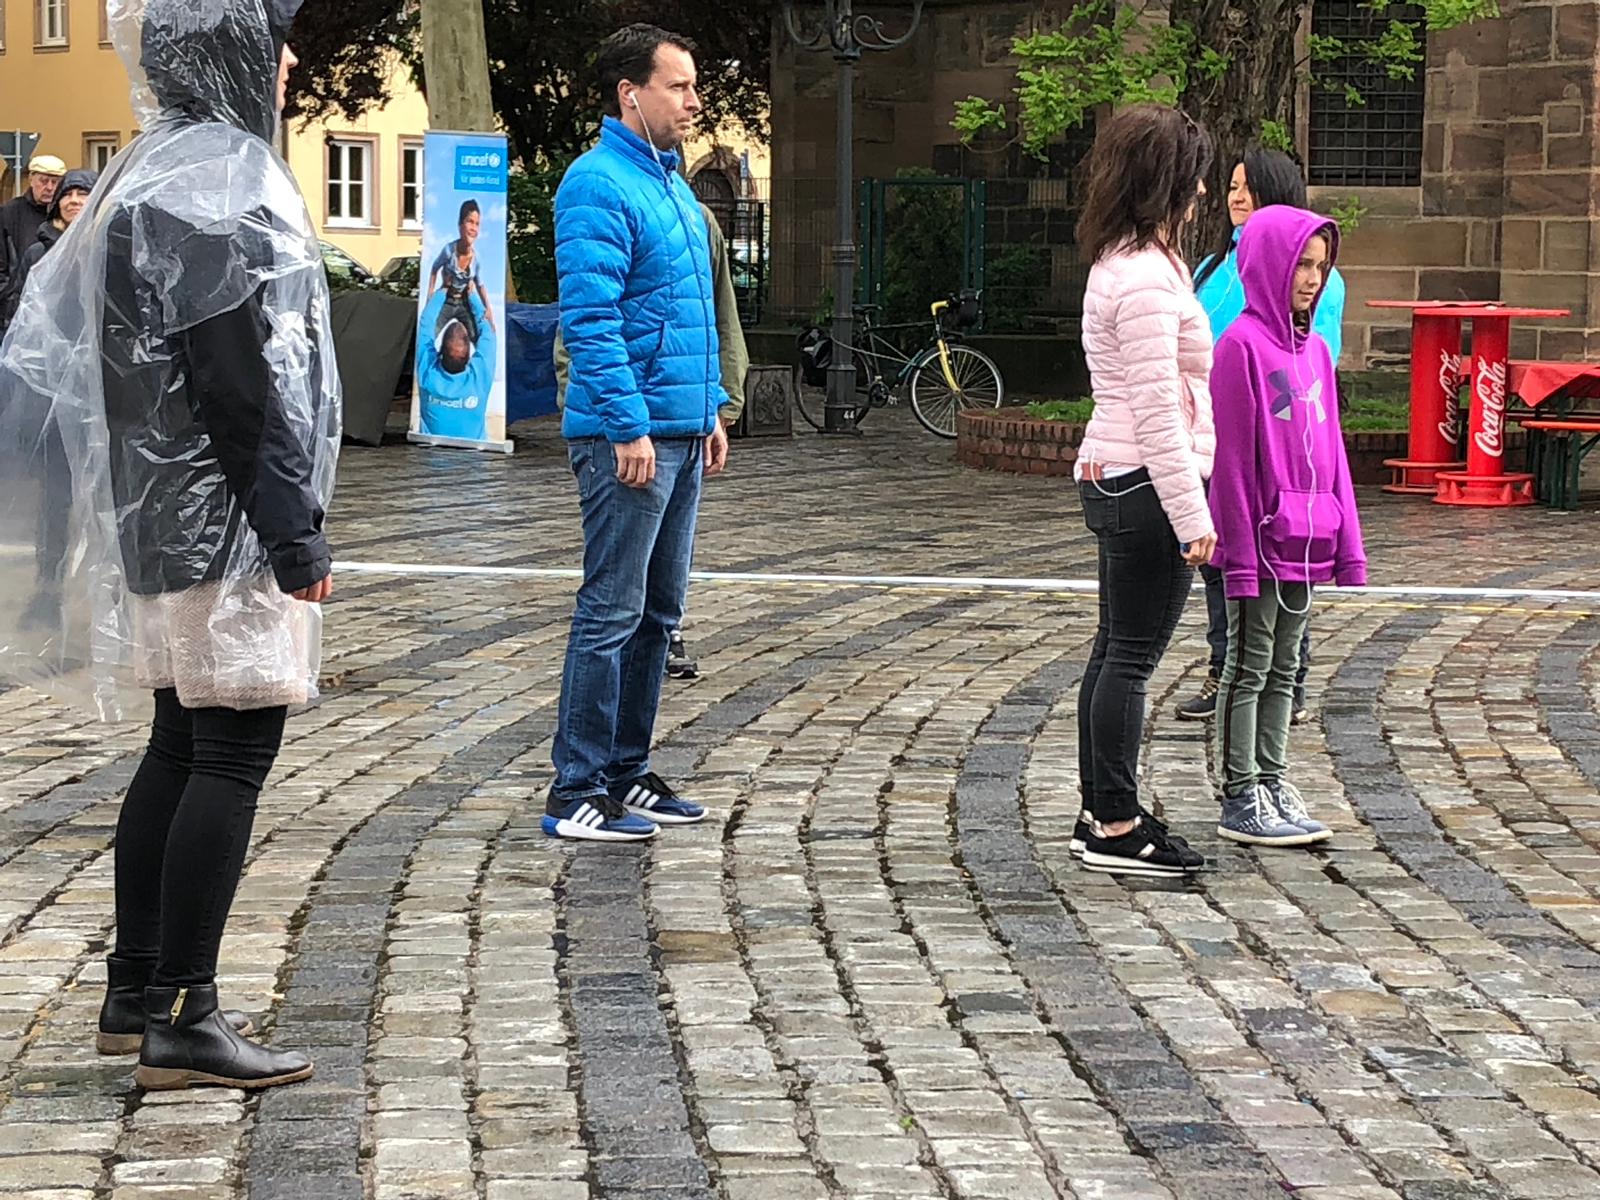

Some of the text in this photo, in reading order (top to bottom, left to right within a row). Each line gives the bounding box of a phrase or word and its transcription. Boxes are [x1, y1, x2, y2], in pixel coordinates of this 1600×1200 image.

[461, 152, 489, 166] unicef
[1473, 355, 1506, 457] Coca-Cola
[843, 410, 854, 419] 44
